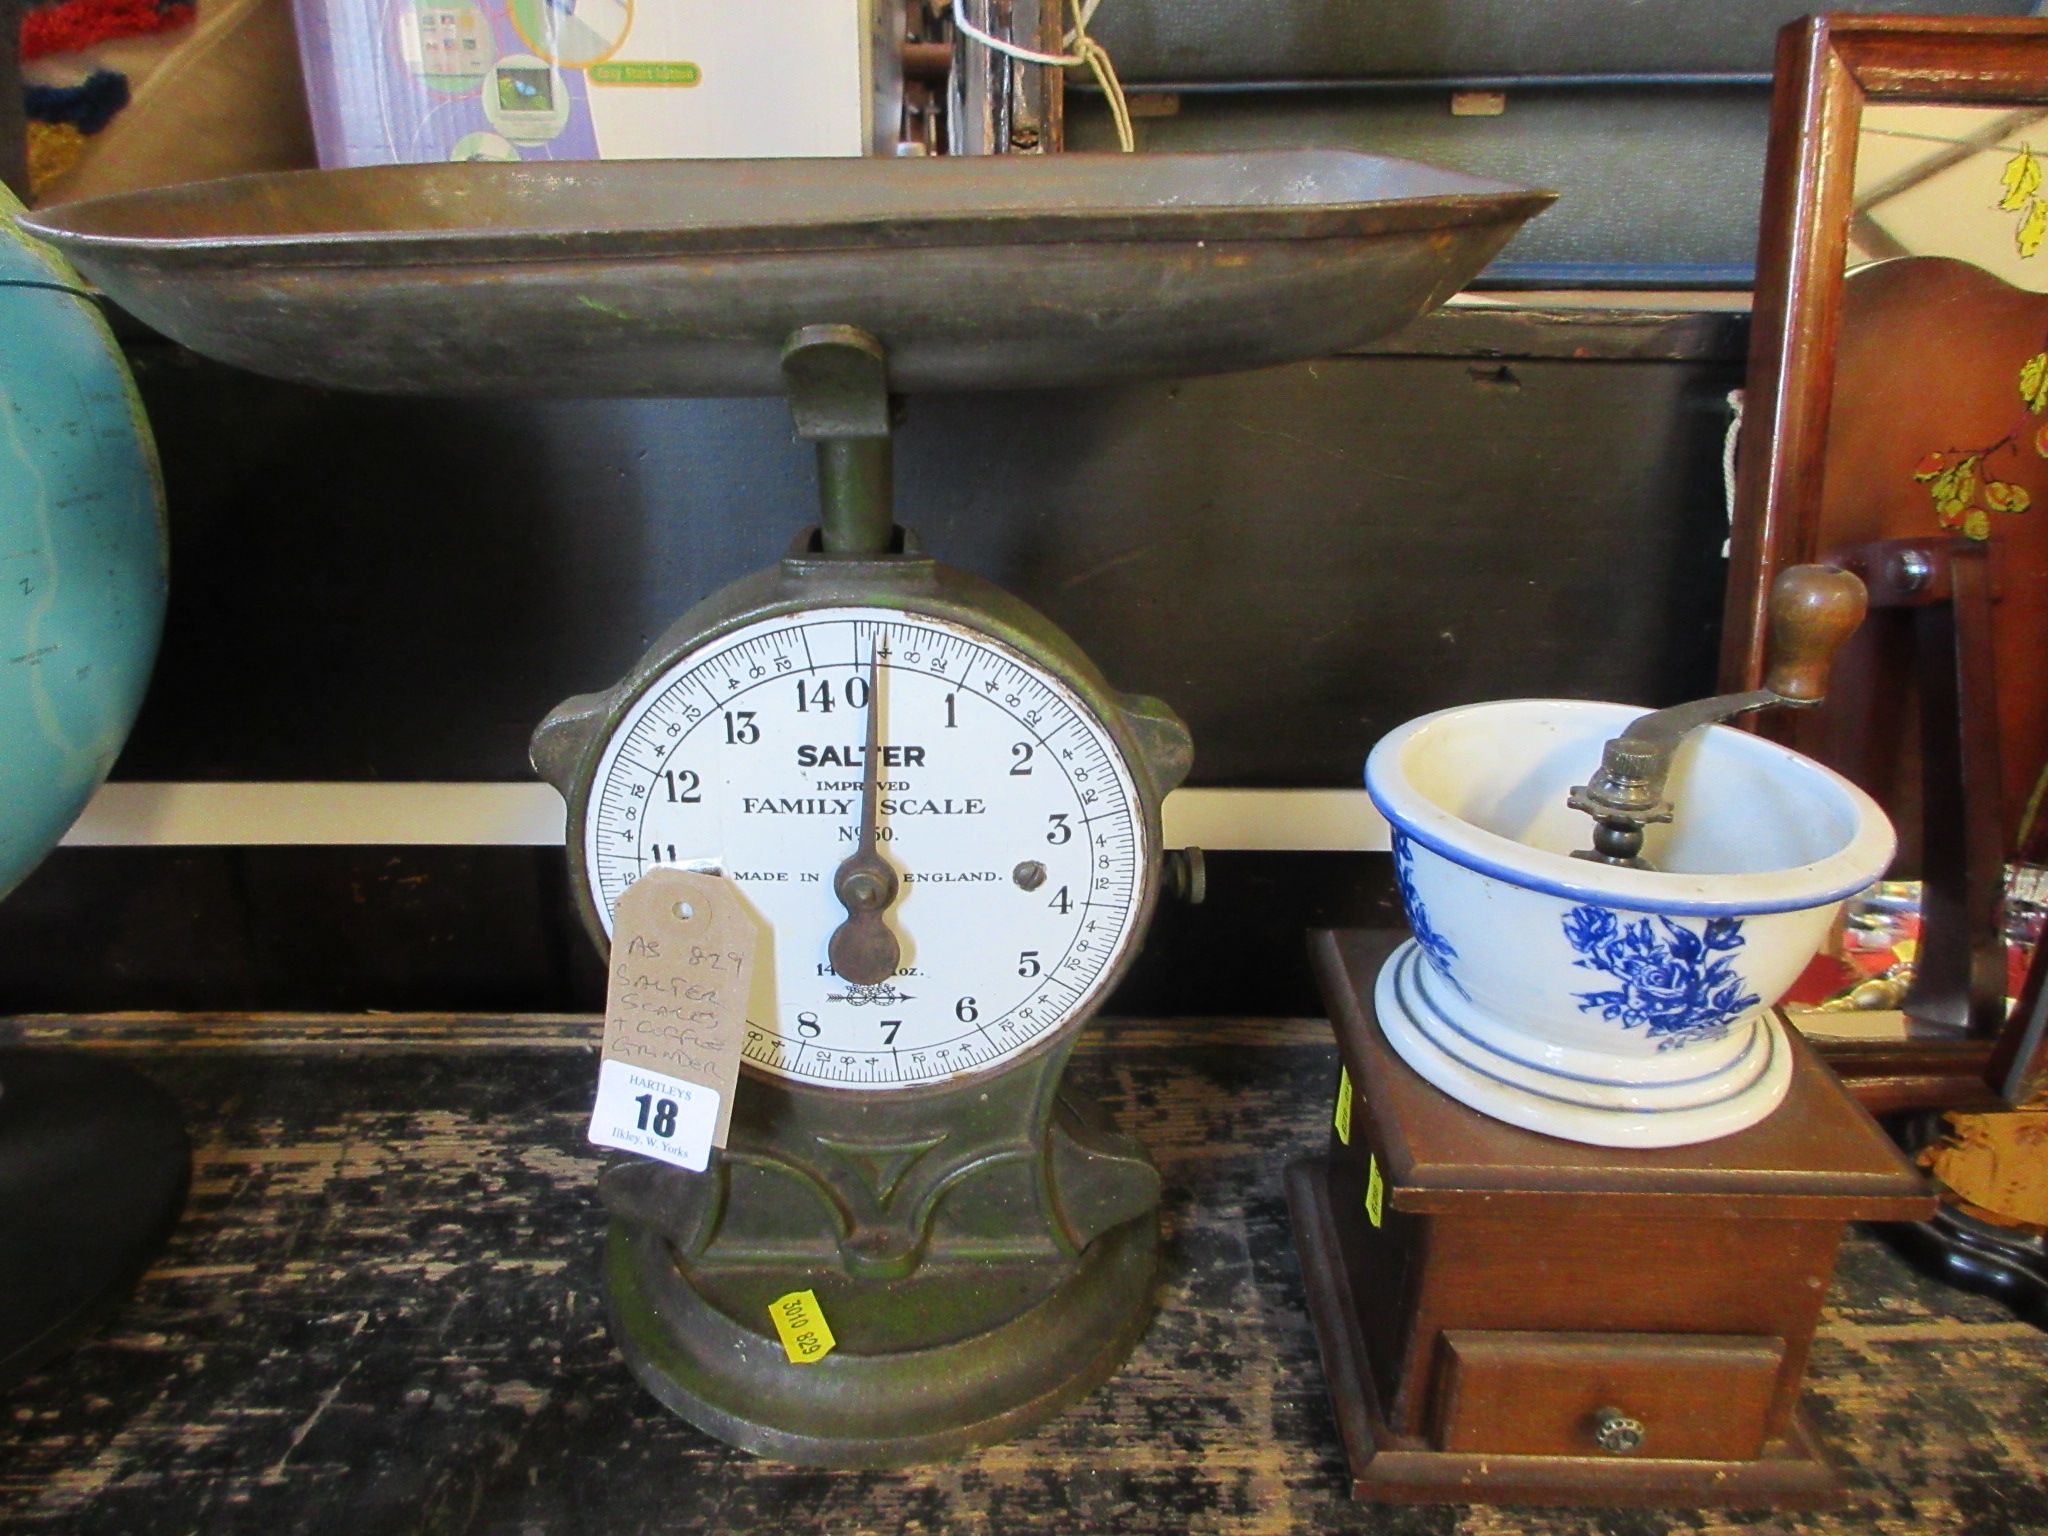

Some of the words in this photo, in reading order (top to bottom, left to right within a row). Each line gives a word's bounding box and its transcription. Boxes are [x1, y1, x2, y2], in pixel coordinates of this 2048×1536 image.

[877, 648, 893, 660] 4
[904, 651, 921, 664] 8
[774, 656, 792, 673] 12
[930, 657, 948, 674] 12
[749, 666, 766, 680] 8
[728, 677, 741, 690] 4
[984, 680, 1000, 694] 4
[796, 679, 836, 713] 14
[845, 676, 870, 709] 0
[1005, 693, 1021, 708] 8
[681, 704, 701, 723] 12
[944, 693, 958, 728] 1
[1023, 709, 1043, 729] 12
[666, 722, 682, 738] 8
[724, 711, 761, 745] 13
[653, 743, 666, 758] 4
[1062, 748, 1074, 762] 4
[1009, 741, 1034, 776] 2
[1074, 767, 1090, 783] 8
[629, 783, 646, 800] 12
[663, 769, 702, 804] 12
[816, 780, 911, 792] IMPRVED
[1080, 788, 1100, 806] 12
[625, 806, 638, 821] 8
[742, 797, 856, 815] FAMILY
[880, 798, 987, 816] SCALE
[622, 829, 635, 843] 4
[1046, 812, 1073, 846] 3
[1095, 833, 1108, 848] 4
[1098, 855, 1110, 869] 8
[622, 872, 636, 886] 12
[733, 871, 789, 882] MADE
[800, 872, 820, 883] IN
[903, 871, 1003, 883] ENGLAND.
[1095, 878, 1110, 890] 12
[1048, 885, 1074, 915] 4
[1085, 920, 1097, 933] 4
[1076, 940, 1090, 952] 8
[816, 963, 836, 977] 14
[1018, 951, 1041, 978] 5
[1063, 956, 1081, 971] 12
[616, 963, 726, 1009] SALTER
[1037, 994, 1049, 1005] 4
[955, 996, 979, 1023] 6
[1019, 1007, 1033, 1019] 8
[797, 1011, 822, 1039] 8
[880, 1020, 903, 1045] 7
[998, 1018, 1015, 1033] 12
[747, 1031, 764, 1042] 8
[771, 1040, 786, 1049] 4
[959, 1043, 973, 1052] 4
[816, 1051, 832, 1063] 12
[840, 1056, 857, 1065] 8
[865, 1057, 880, 1066] 4
[911, 1051, 927, 1063] 12
[936, 1049, 950, 1059] 8
[629, 1074, 692, 1101] HARTLEYS
[635, 1093, 679, 1138] 18
[611, 1126, 643, 1146] Ilkley,
[645, 1136, 659, 1150] W.
[661, 1141, 689, 1159] Yorks
[782, 1299, 809, 1329] 3010
[796, 1331, 822, 1355] 829
